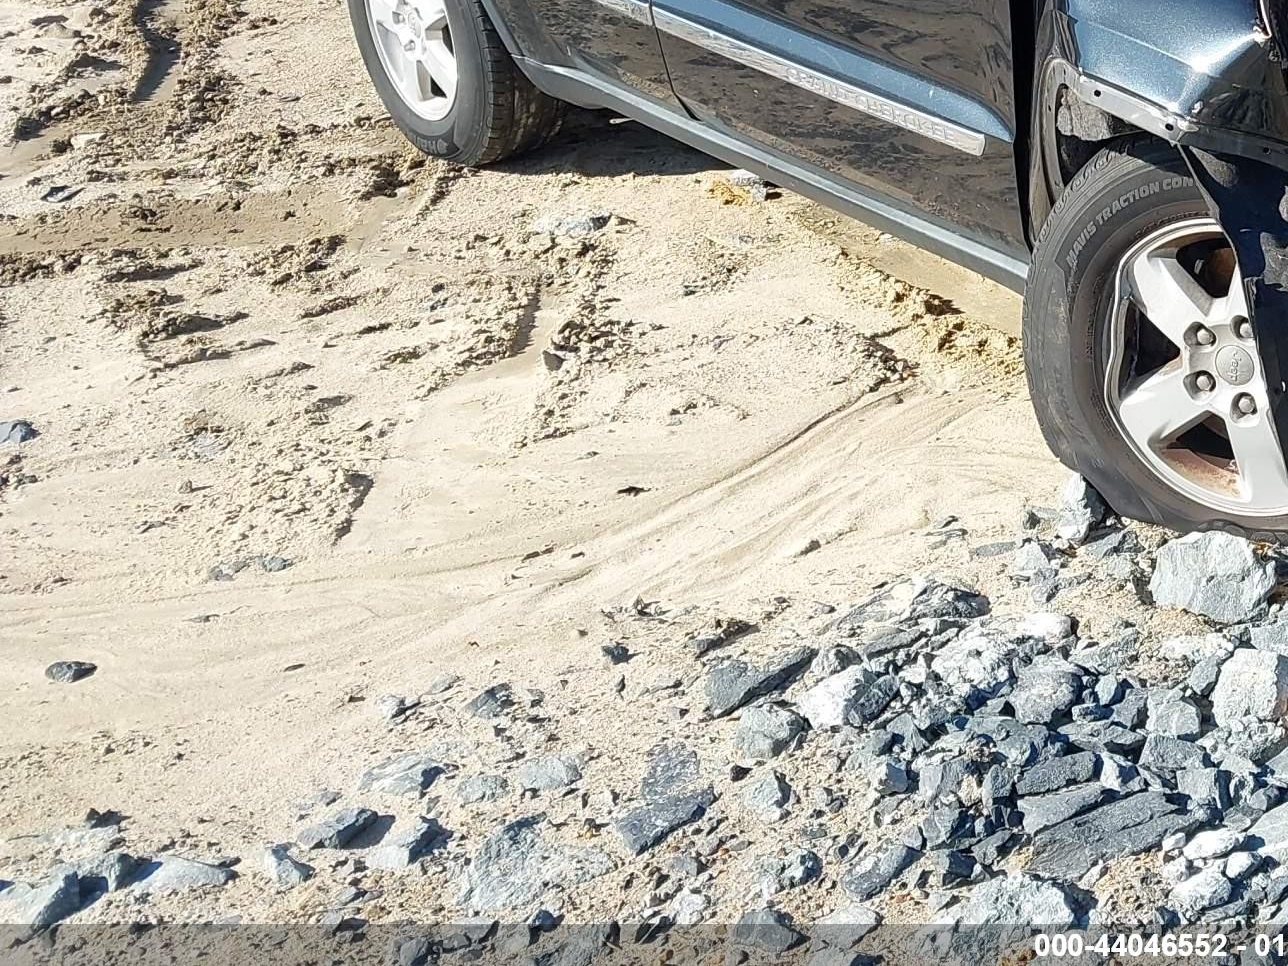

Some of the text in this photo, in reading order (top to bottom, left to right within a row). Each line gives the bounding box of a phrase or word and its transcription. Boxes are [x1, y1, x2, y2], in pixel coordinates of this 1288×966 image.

[785, 67, 956, 142] GRAND CHEROKEE
[1065, 221, 1097, 268] MAVIS
[1095, 181, 1160, 226] TRACTION
[1162, 176, 1199, 191] CON
